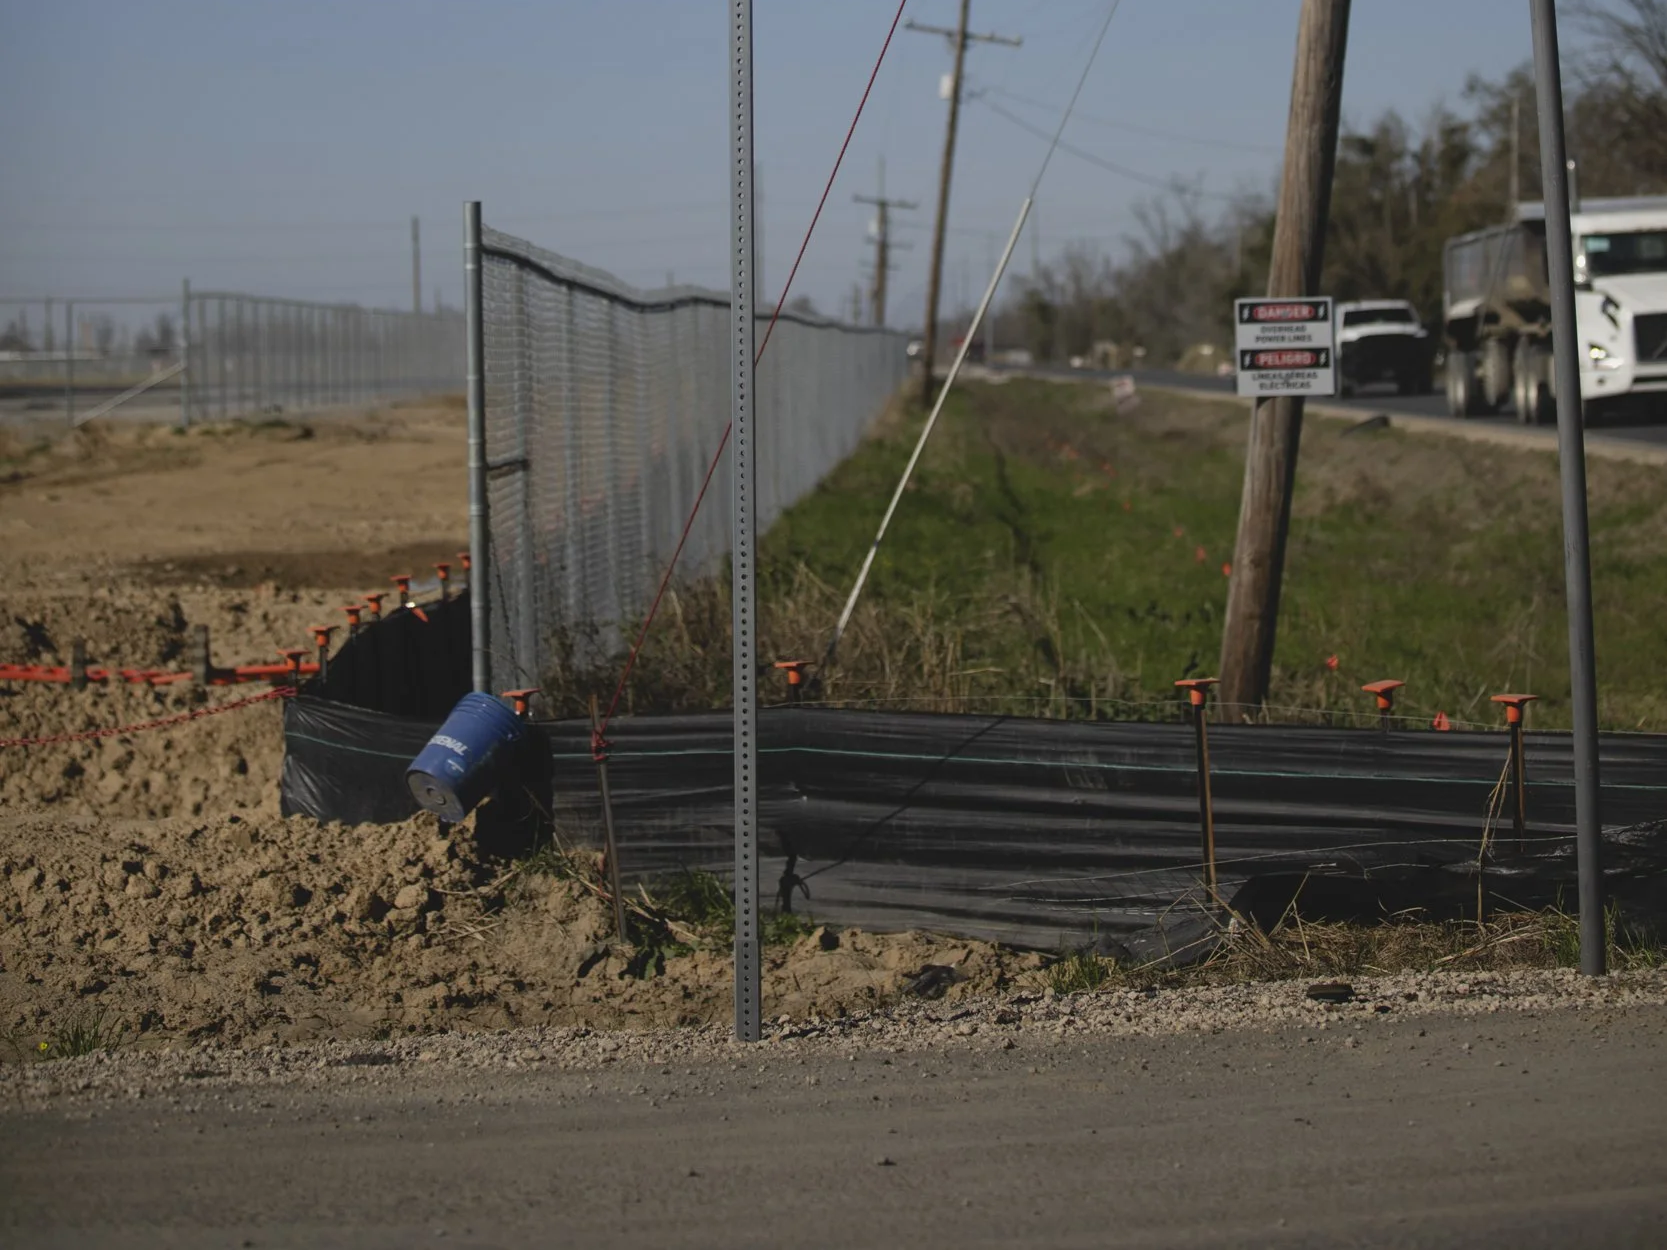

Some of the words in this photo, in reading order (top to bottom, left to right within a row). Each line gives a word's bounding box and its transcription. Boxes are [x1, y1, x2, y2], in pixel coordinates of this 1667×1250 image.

[1257, 305, 1310, 320] DANGER
[1260, 325, 1307, 333] OVERHEAD
[1255, 335, 1286, 343] POWER
[1288, 334, 1312, 342] LINES
[1259, 351, 1312, 367] PELIGRO
